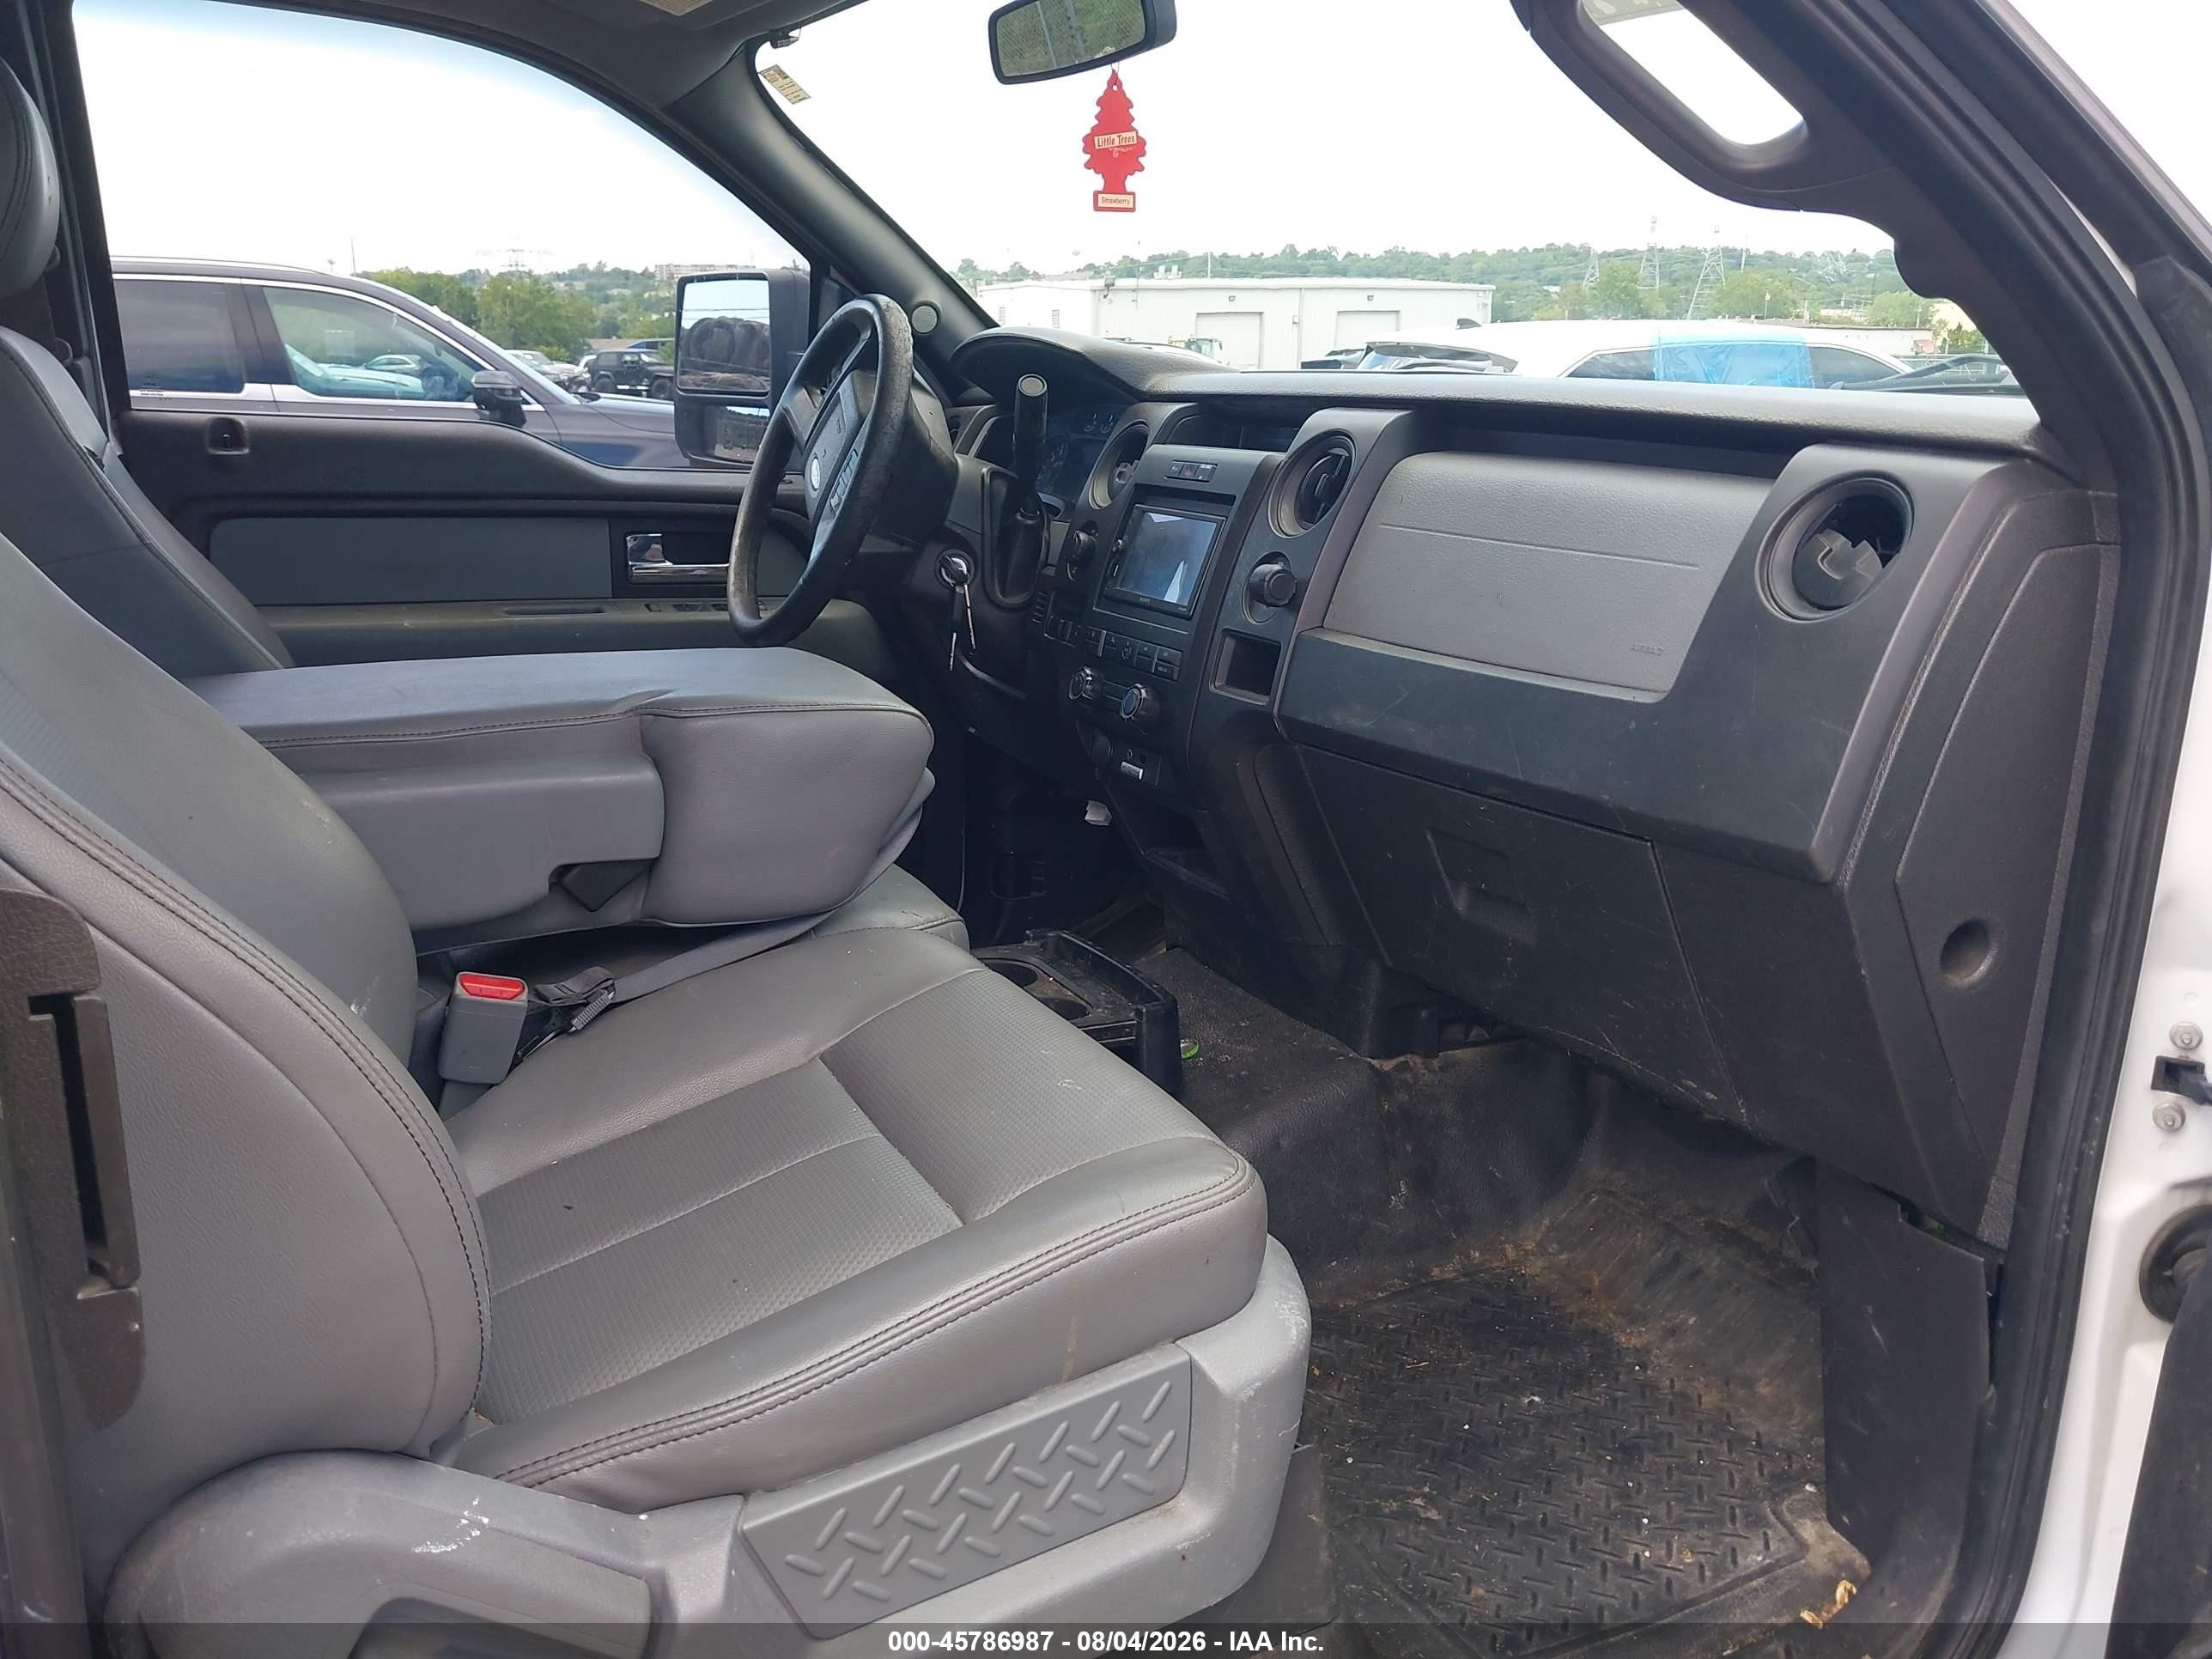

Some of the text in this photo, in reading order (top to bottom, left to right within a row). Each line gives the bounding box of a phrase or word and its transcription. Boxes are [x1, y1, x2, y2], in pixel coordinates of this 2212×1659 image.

[1097, 134, 1134, 147] Little Trees
[1102, 197, 1130, 206] Strawberry
